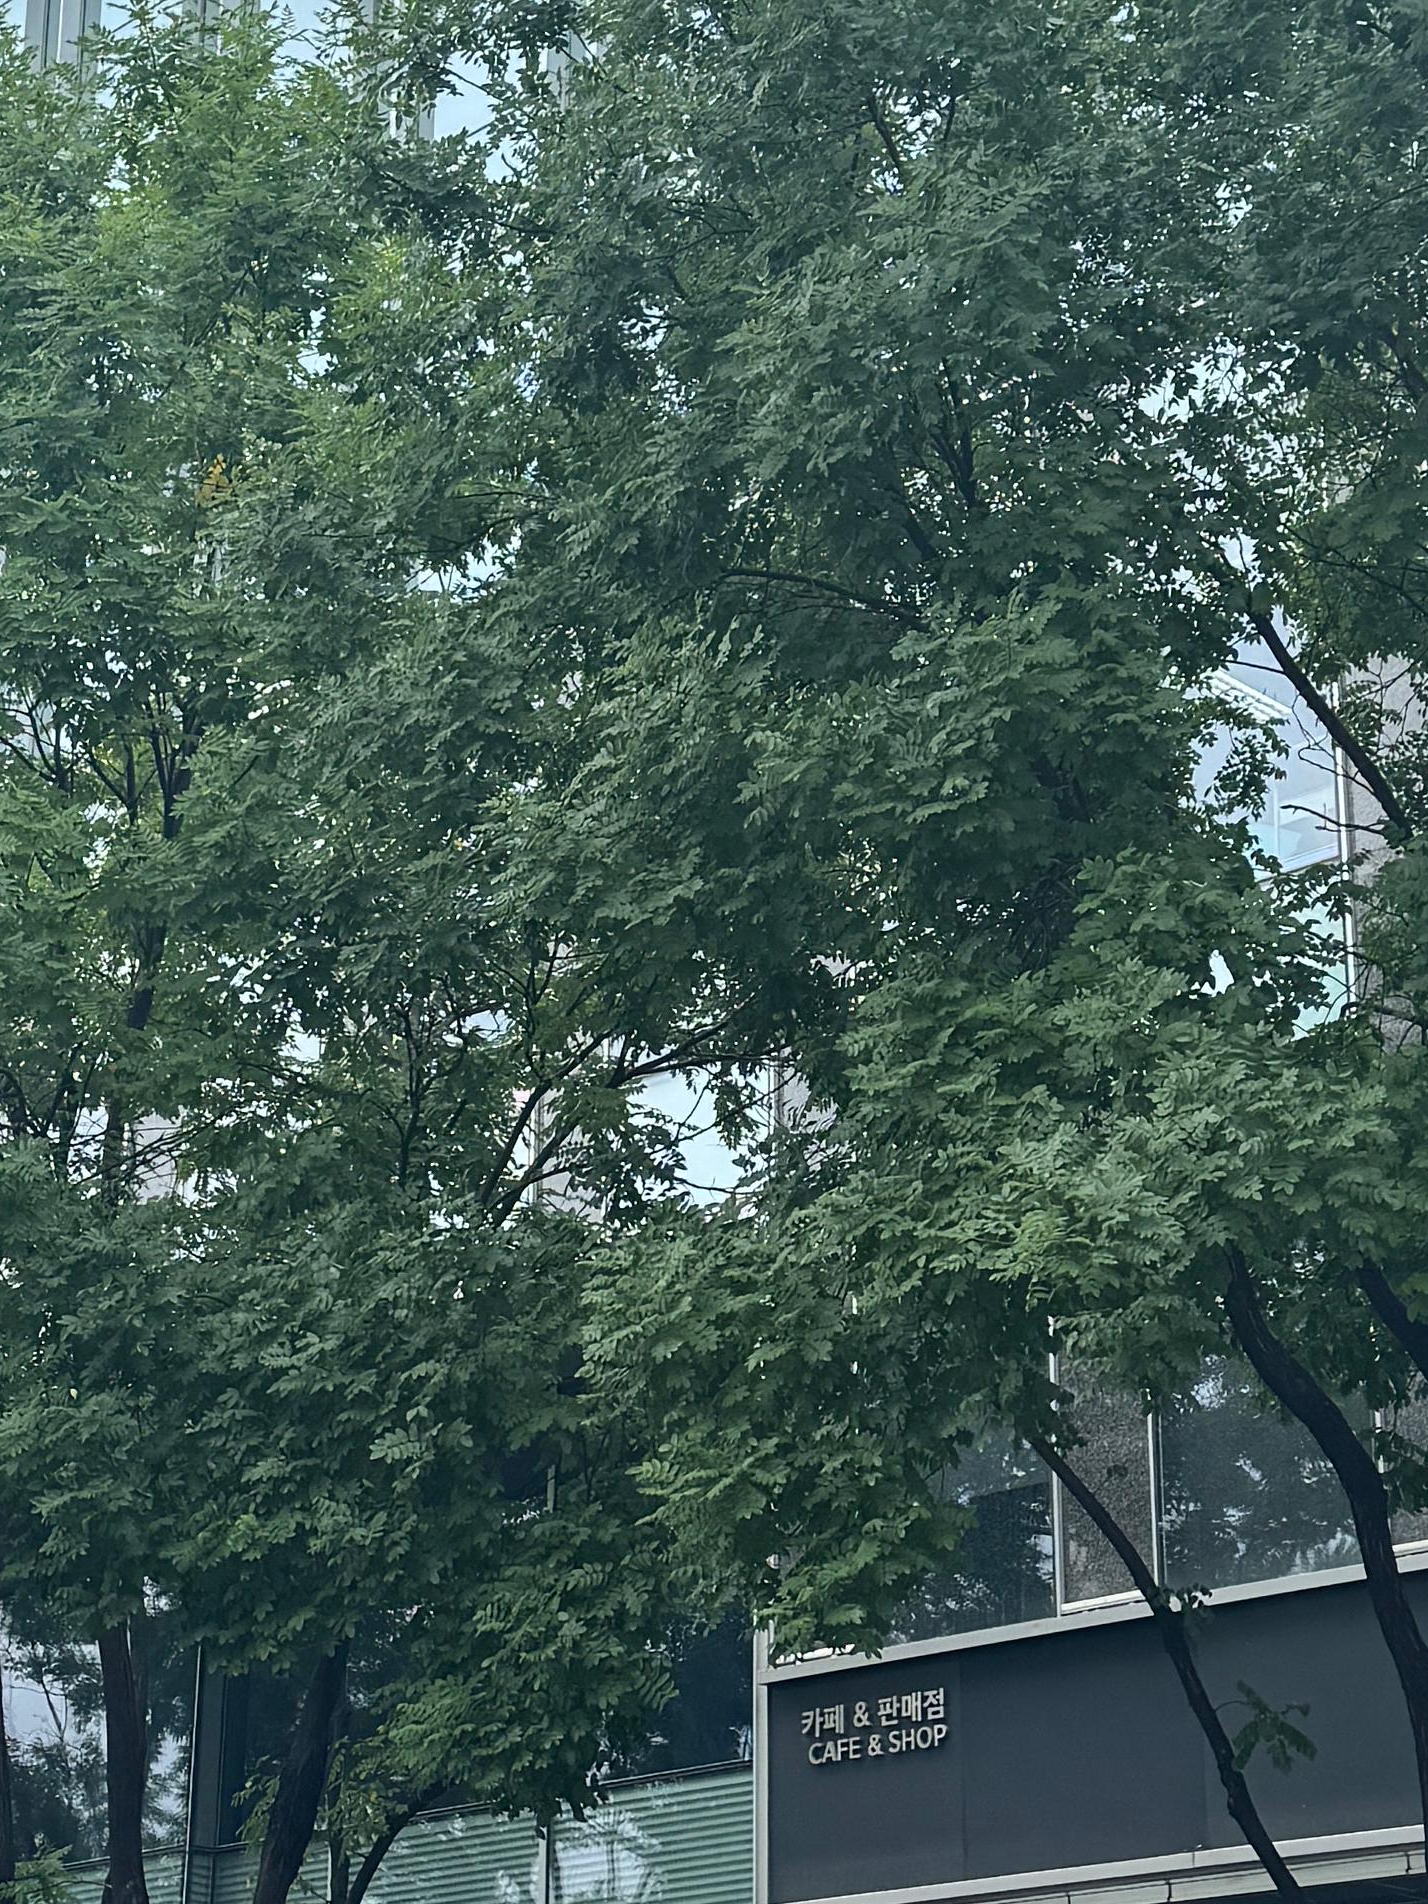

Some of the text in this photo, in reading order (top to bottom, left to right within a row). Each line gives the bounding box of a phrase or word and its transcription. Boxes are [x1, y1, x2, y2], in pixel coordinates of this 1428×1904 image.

[801, 1687, 945, 1738] 카페 & 판매점
[808, 1724, 948, 1766] CAFE & SHOP
